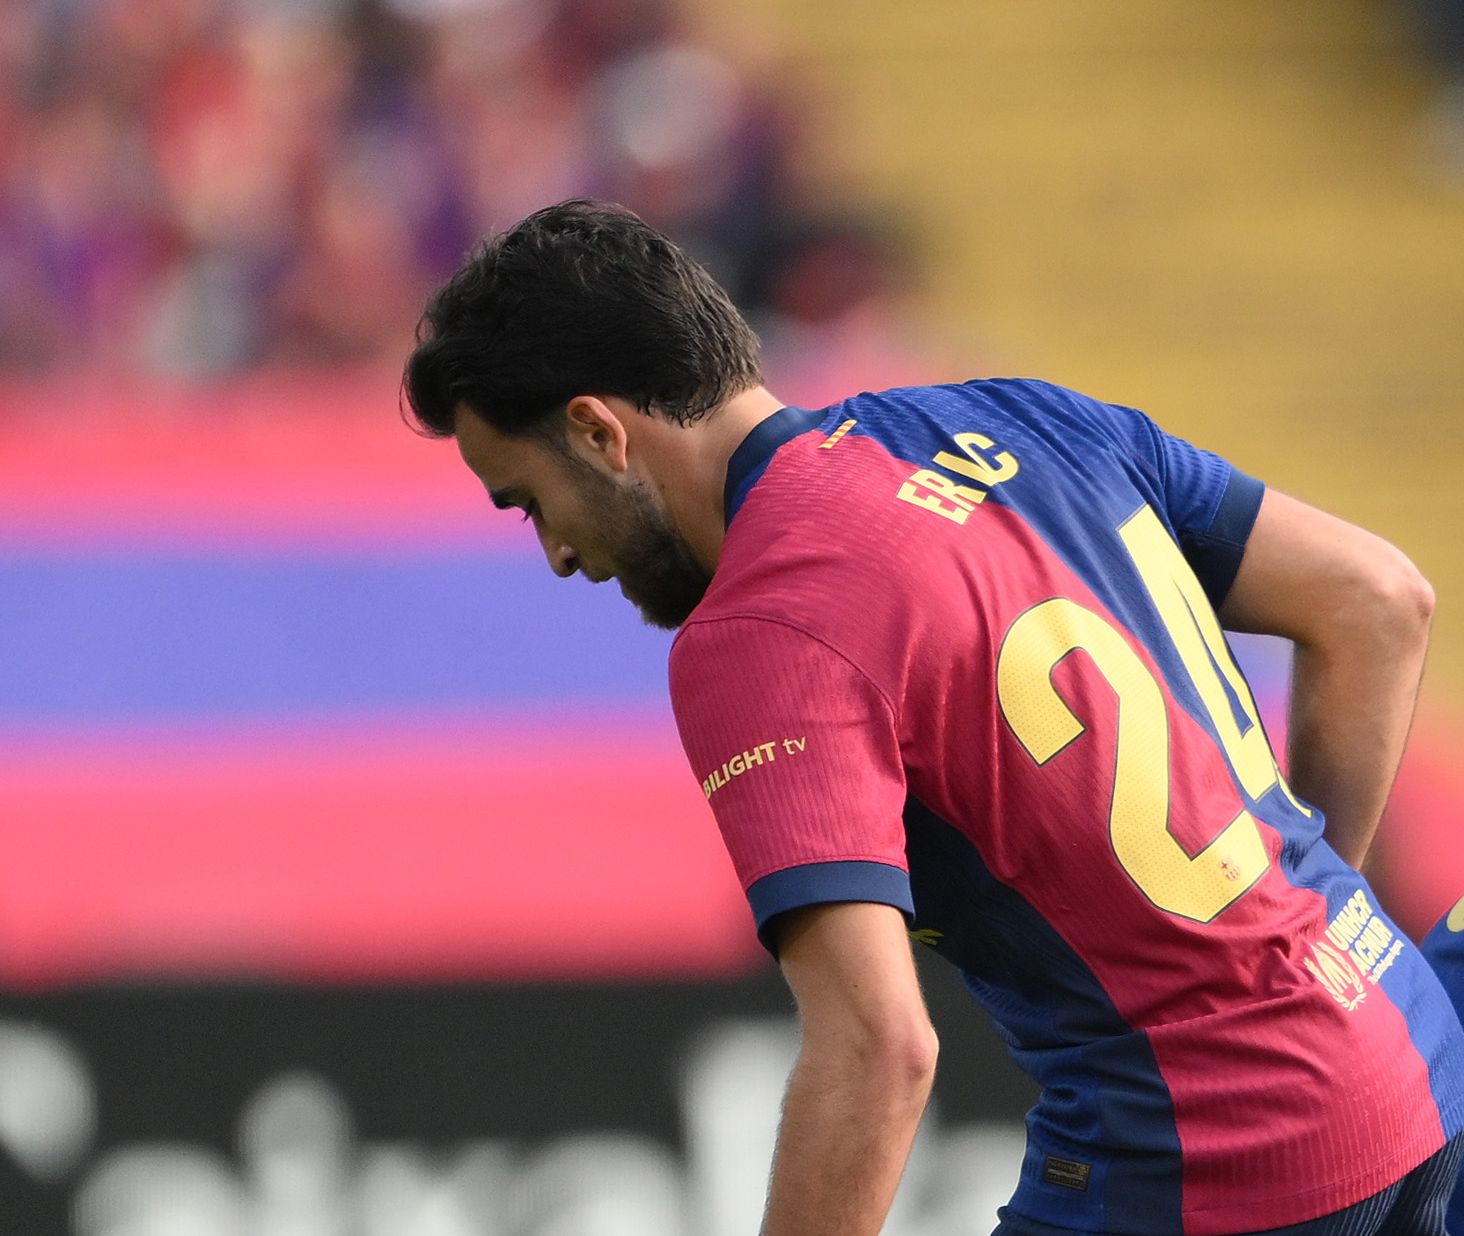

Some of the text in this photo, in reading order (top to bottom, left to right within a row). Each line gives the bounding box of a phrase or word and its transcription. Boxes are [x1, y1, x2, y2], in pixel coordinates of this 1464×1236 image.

[896, 432, 1019, 525] ERIC
[995, 503, 1313, 924] 24
[782, 736, 806, 755] tv
[1324, 889, 1373, 951] UNHCR
[1348, 916, 1393, 976] ACNUR
